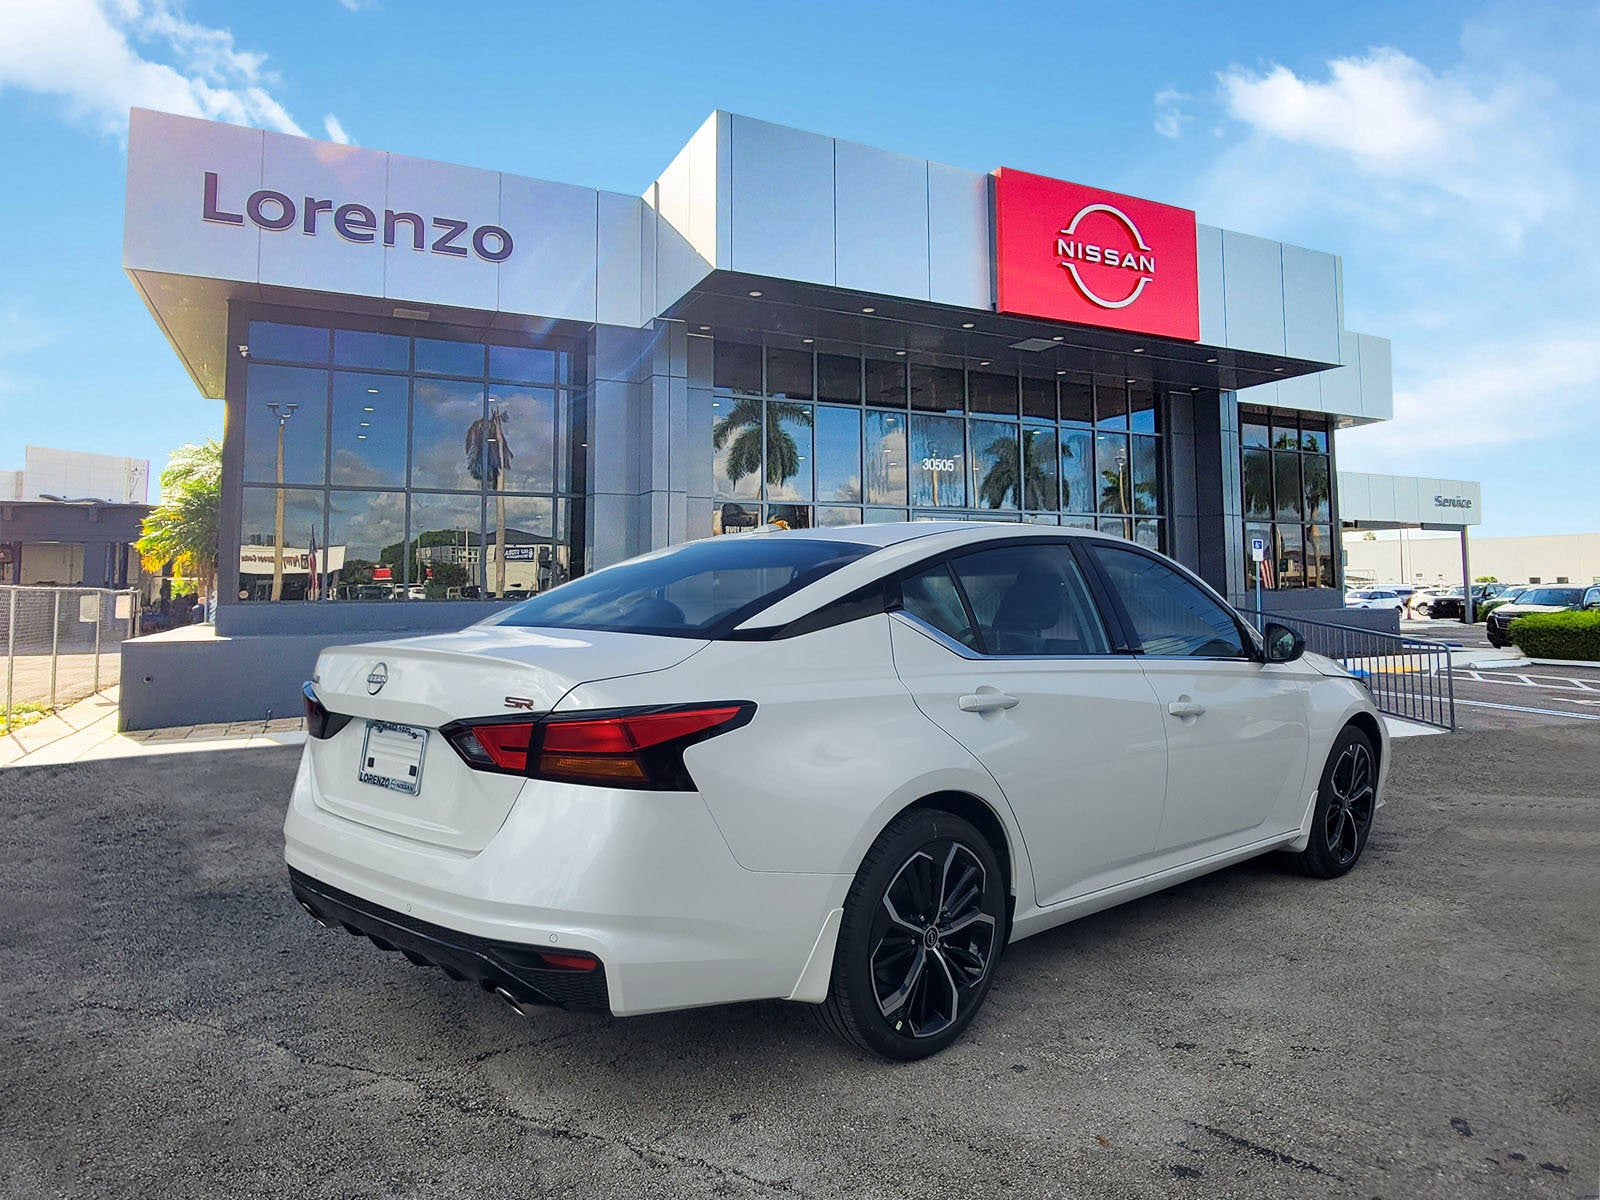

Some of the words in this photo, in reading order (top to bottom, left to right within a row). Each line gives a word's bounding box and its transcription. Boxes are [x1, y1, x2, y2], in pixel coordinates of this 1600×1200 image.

[202, 171, 515, 263] Lorenzo
[1057, 238, 1155, 273] NISSAN
[922, 458, 955, 471] 30505
[1434, 495, 1472, 508] Service
[504, 696, 534, 710] SR
[359, 772, 391, 788] LORENZO
